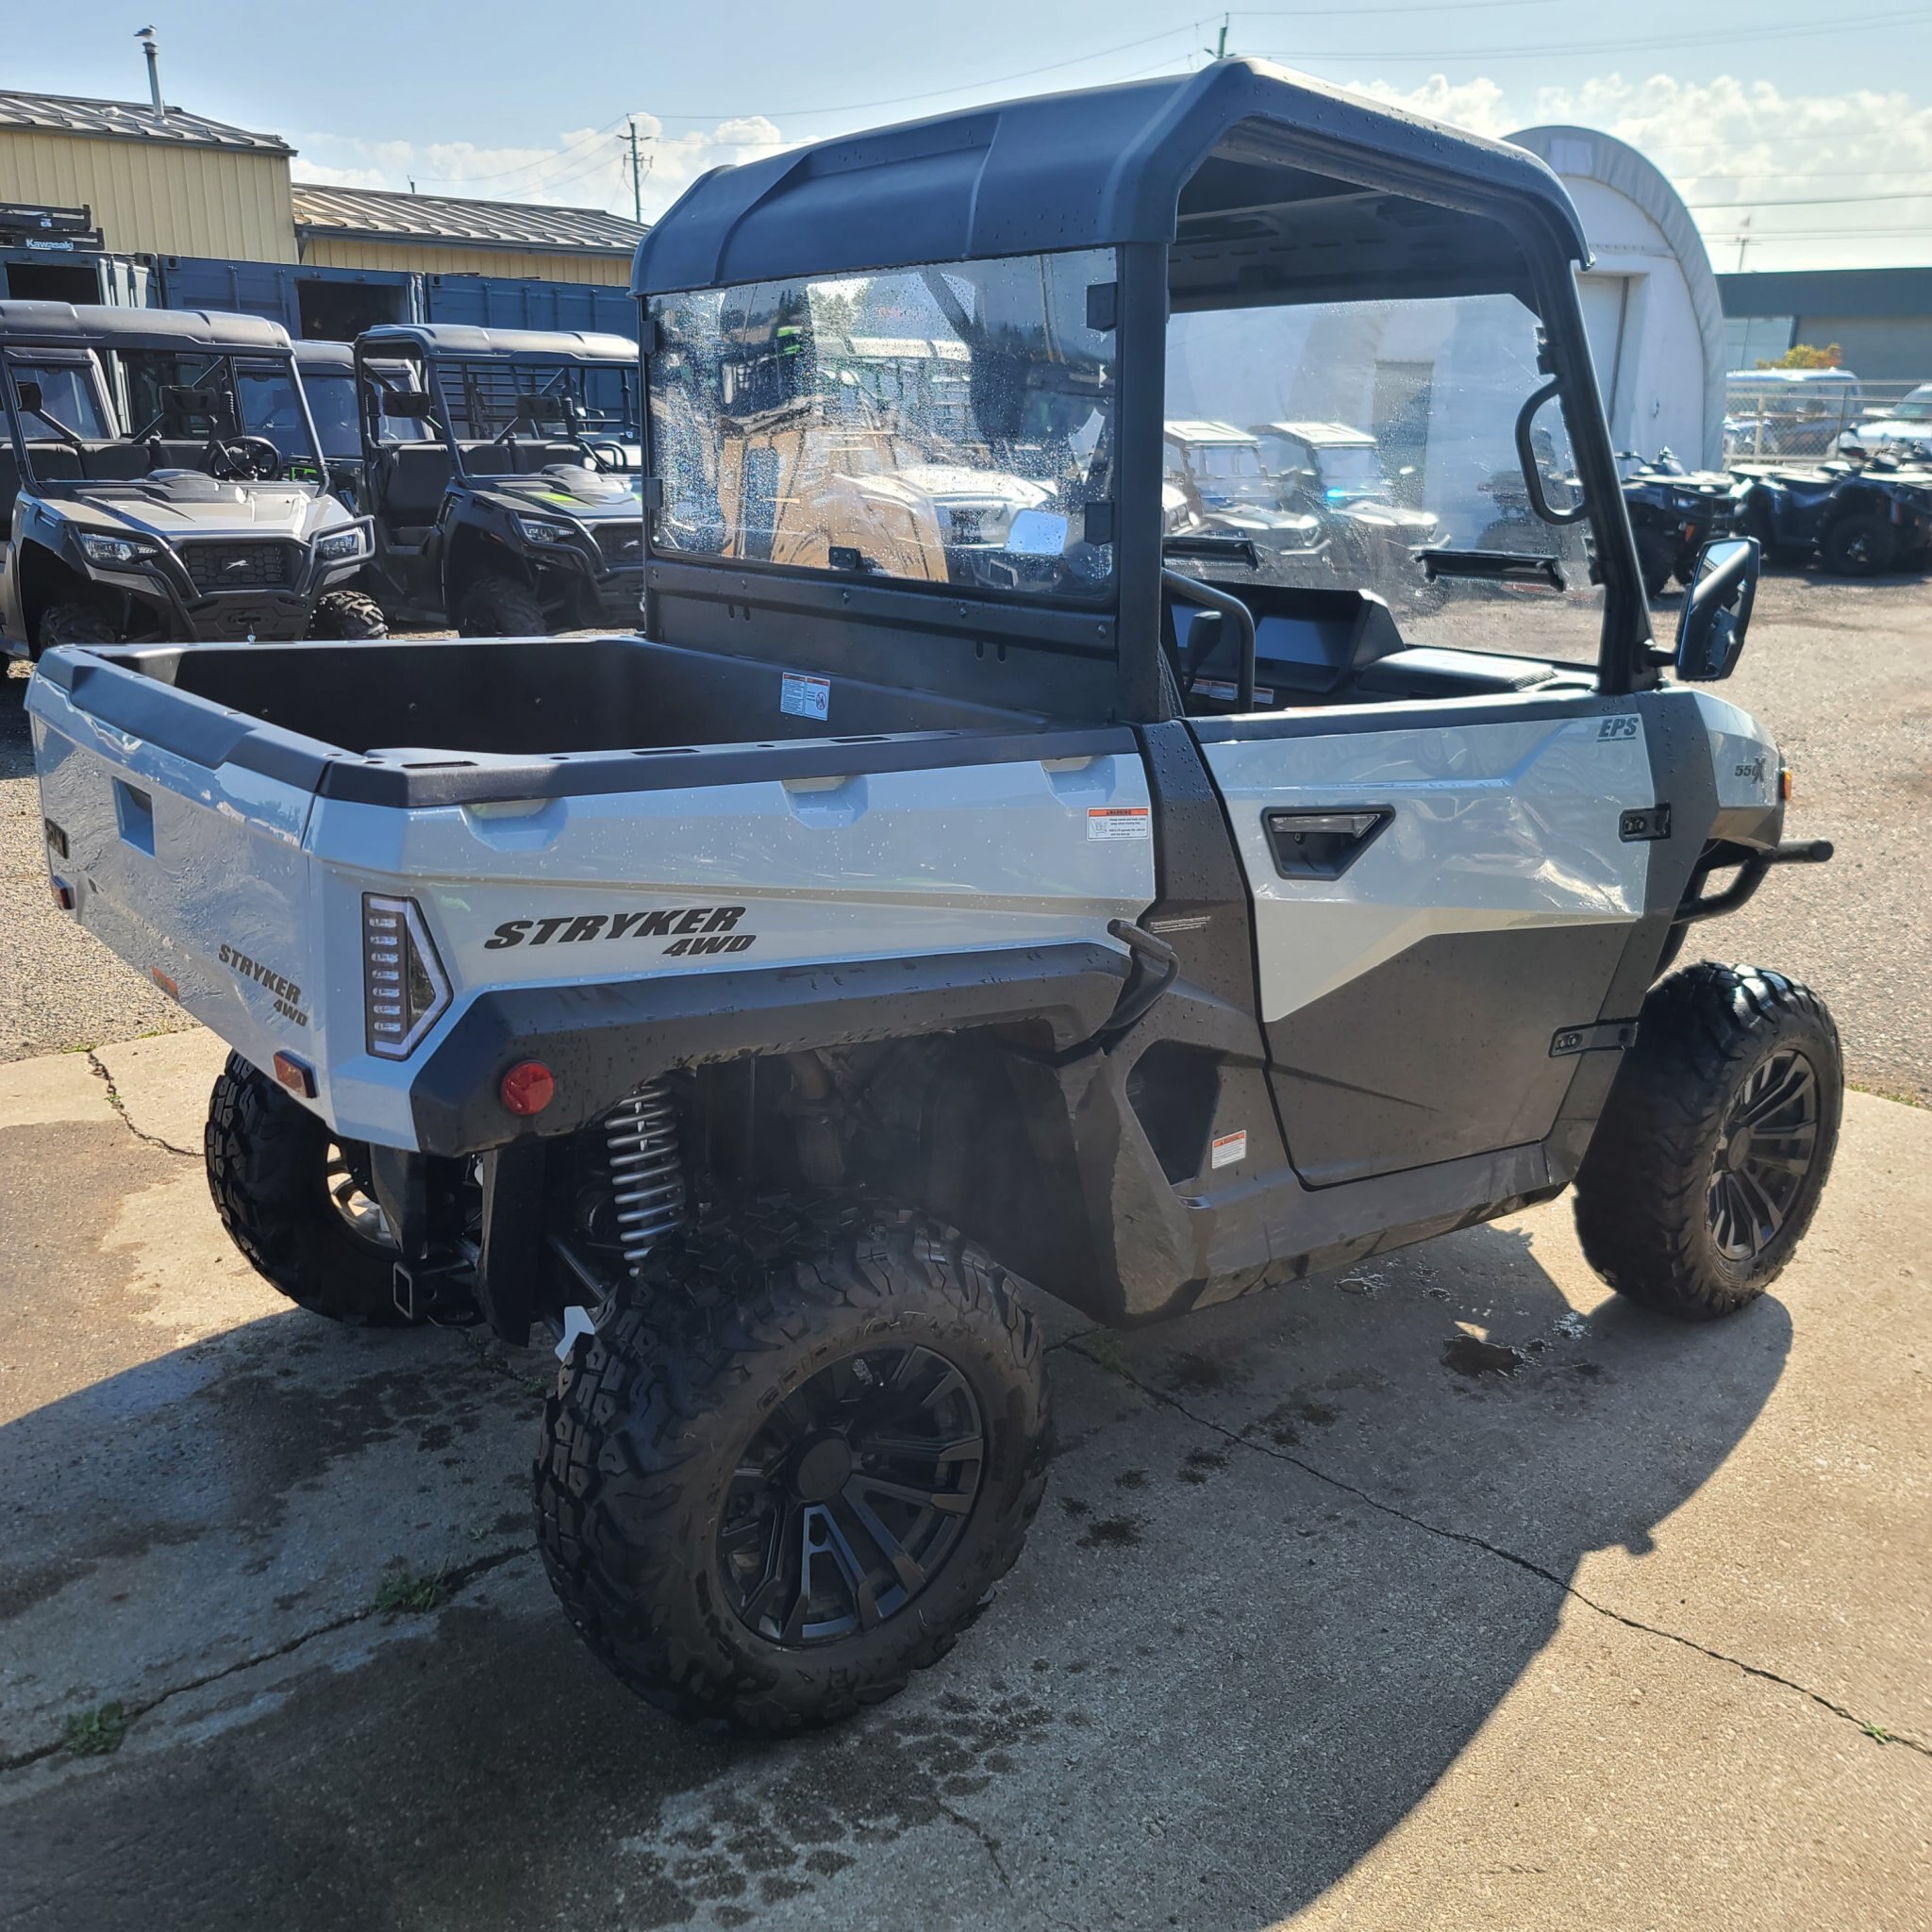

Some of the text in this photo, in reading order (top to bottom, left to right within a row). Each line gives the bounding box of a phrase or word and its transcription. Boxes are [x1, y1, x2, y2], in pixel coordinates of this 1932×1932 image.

[25, 238, 74, 250] Kawasaki
[1598, 717, 1639, 737] EPS
[484, 907, 746, 949] STRYKER
[662, 935, 757, 957] 4WD
[218, 944, 301, 1005] STRYKER
[274, 999, 308, 1026] 4WD
